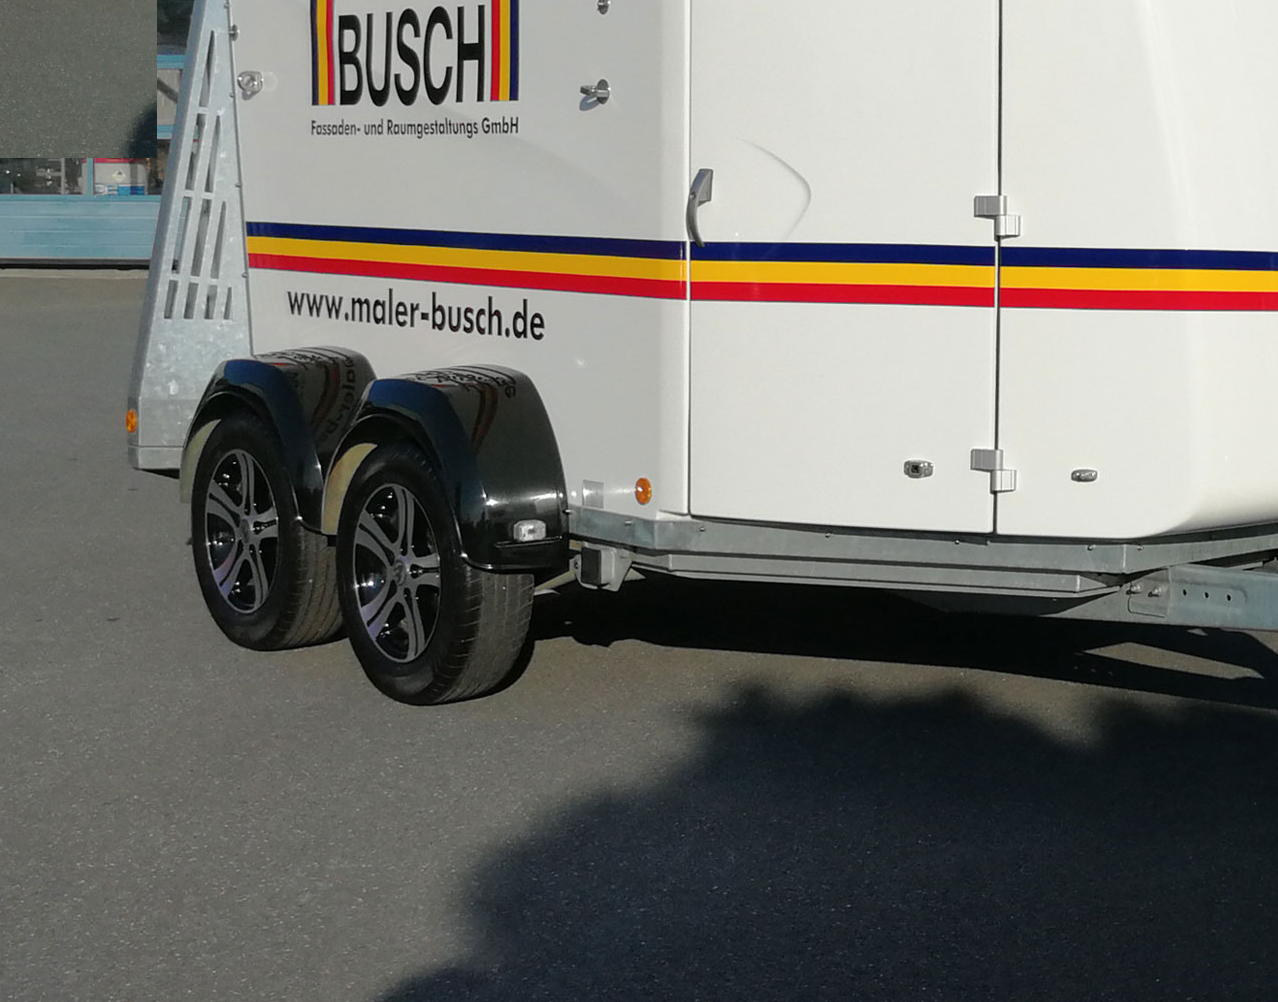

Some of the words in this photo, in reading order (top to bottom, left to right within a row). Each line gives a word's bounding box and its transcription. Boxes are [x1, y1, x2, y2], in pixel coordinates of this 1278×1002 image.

[338, 4, 485, 107] BUSCH
[311, 120, 361, 136] Fassaden-
[364, 119, 384, 136] und
[387, 118, 479, 139] Raumgestaltungs
[481, 116, 519, 135] GmbH
[287, 288, 545, 340] www.maler-busch.de
